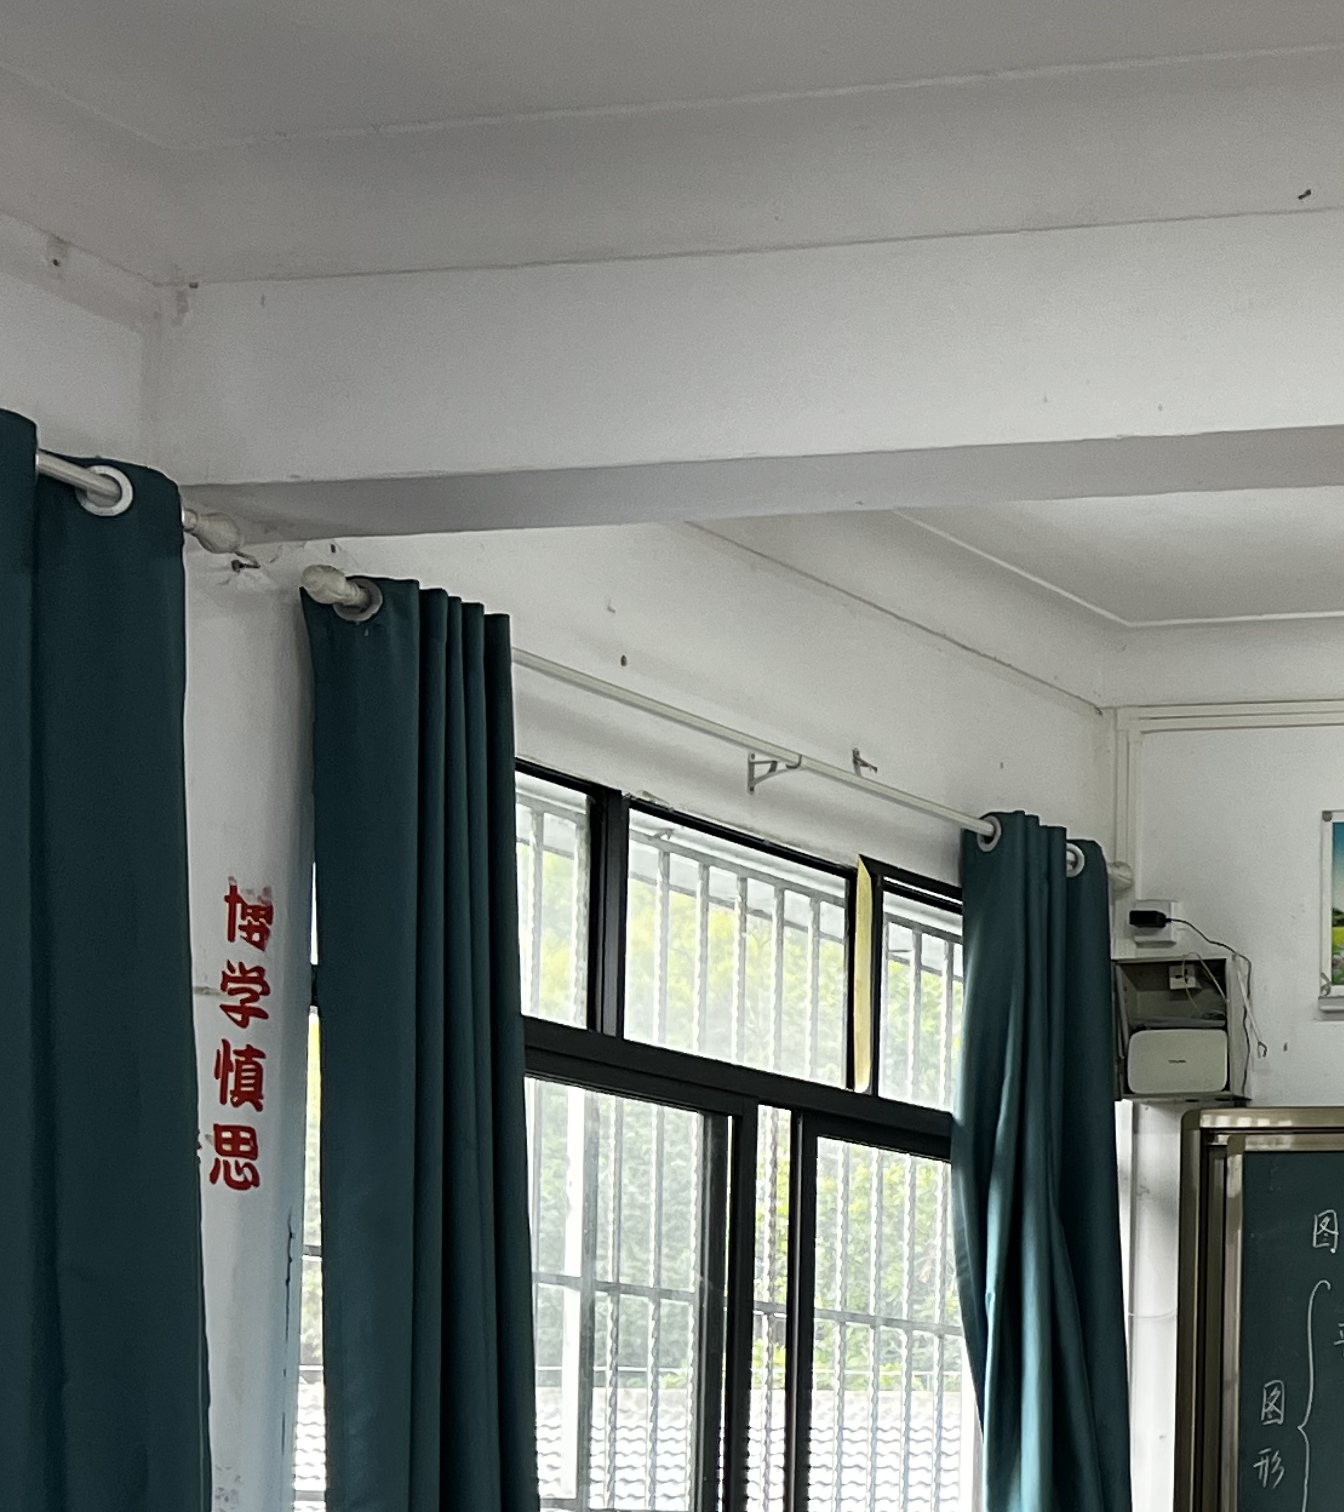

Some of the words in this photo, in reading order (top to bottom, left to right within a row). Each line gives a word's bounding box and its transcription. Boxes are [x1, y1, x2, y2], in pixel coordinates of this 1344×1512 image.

[209, 875, 275, 1191] 博学慎思
[1253, 1379, 1286, 1488] 图形
